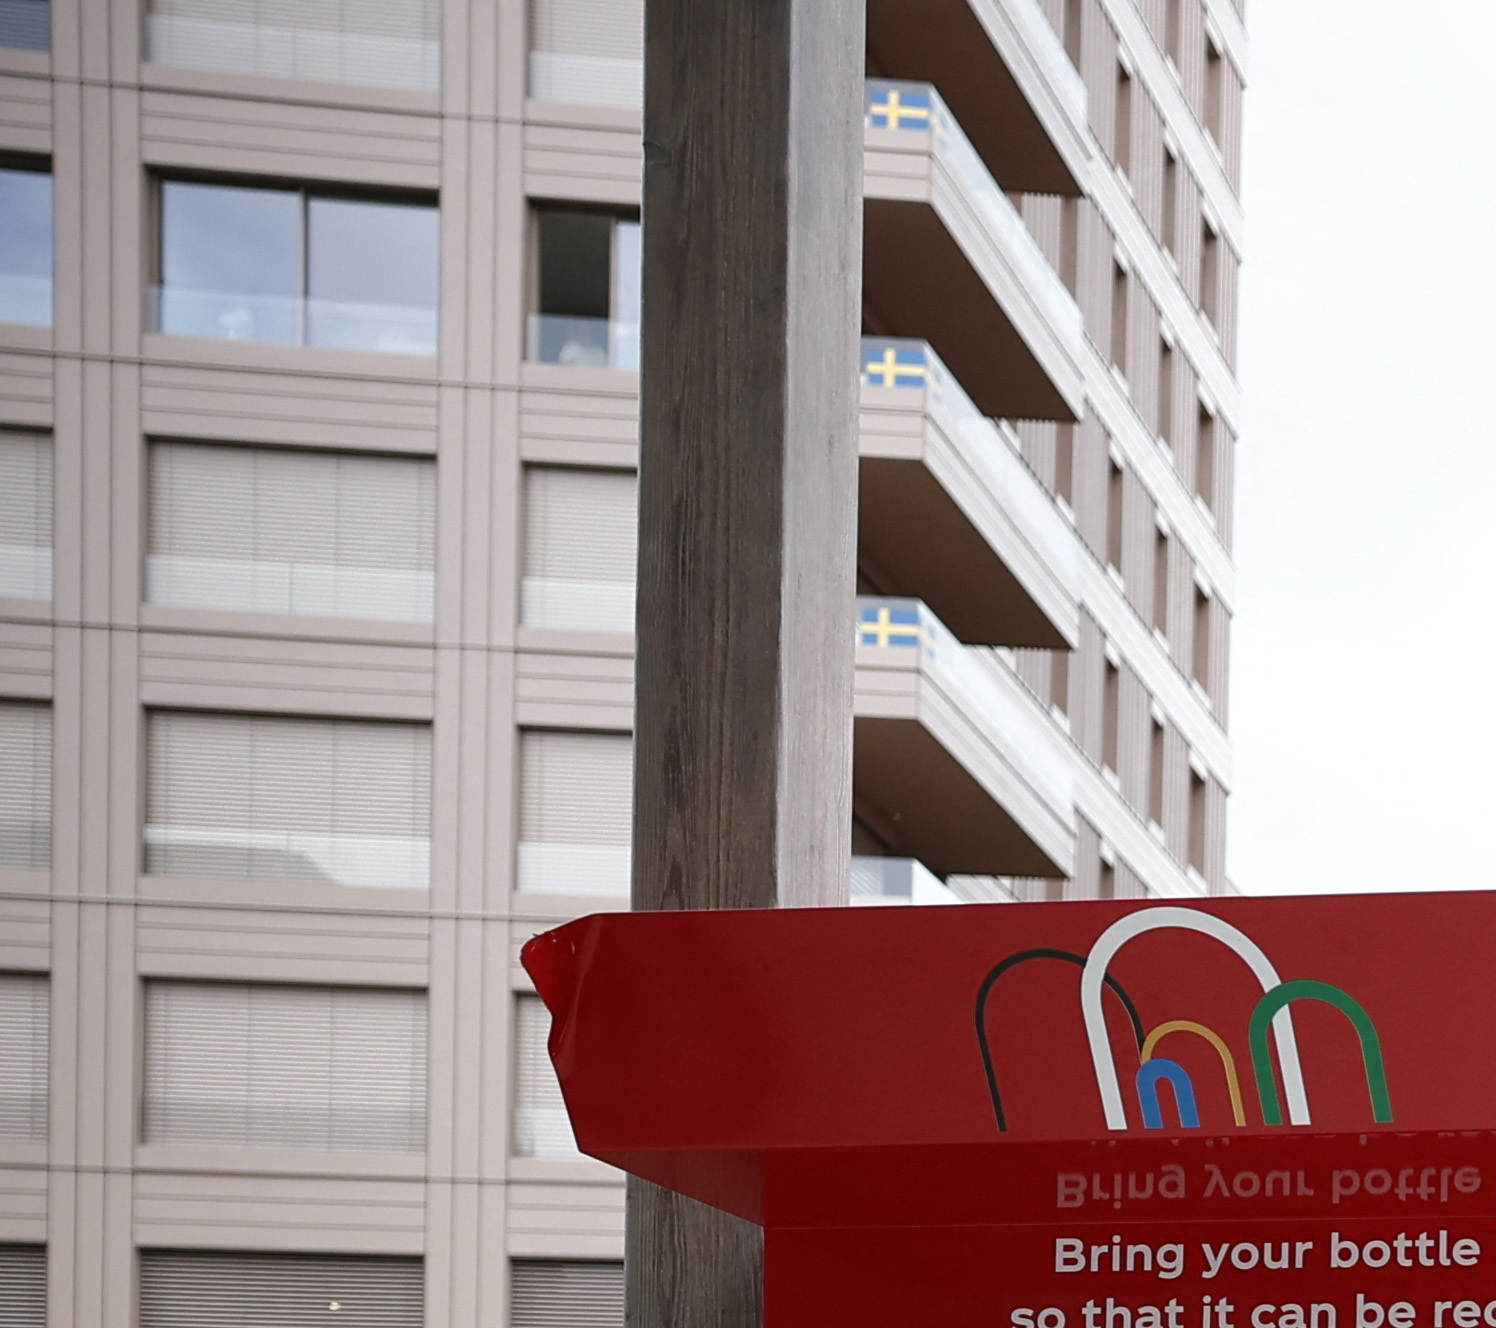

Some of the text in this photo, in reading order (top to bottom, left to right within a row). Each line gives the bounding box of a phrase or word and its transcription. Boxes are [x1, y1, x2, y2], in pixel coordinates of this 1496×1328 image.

[1055, 1234, 1185, 1280] Bring
[1201, 1241, 1314, 1279] your
[1330, 1229, 1481, 1269] bottle
